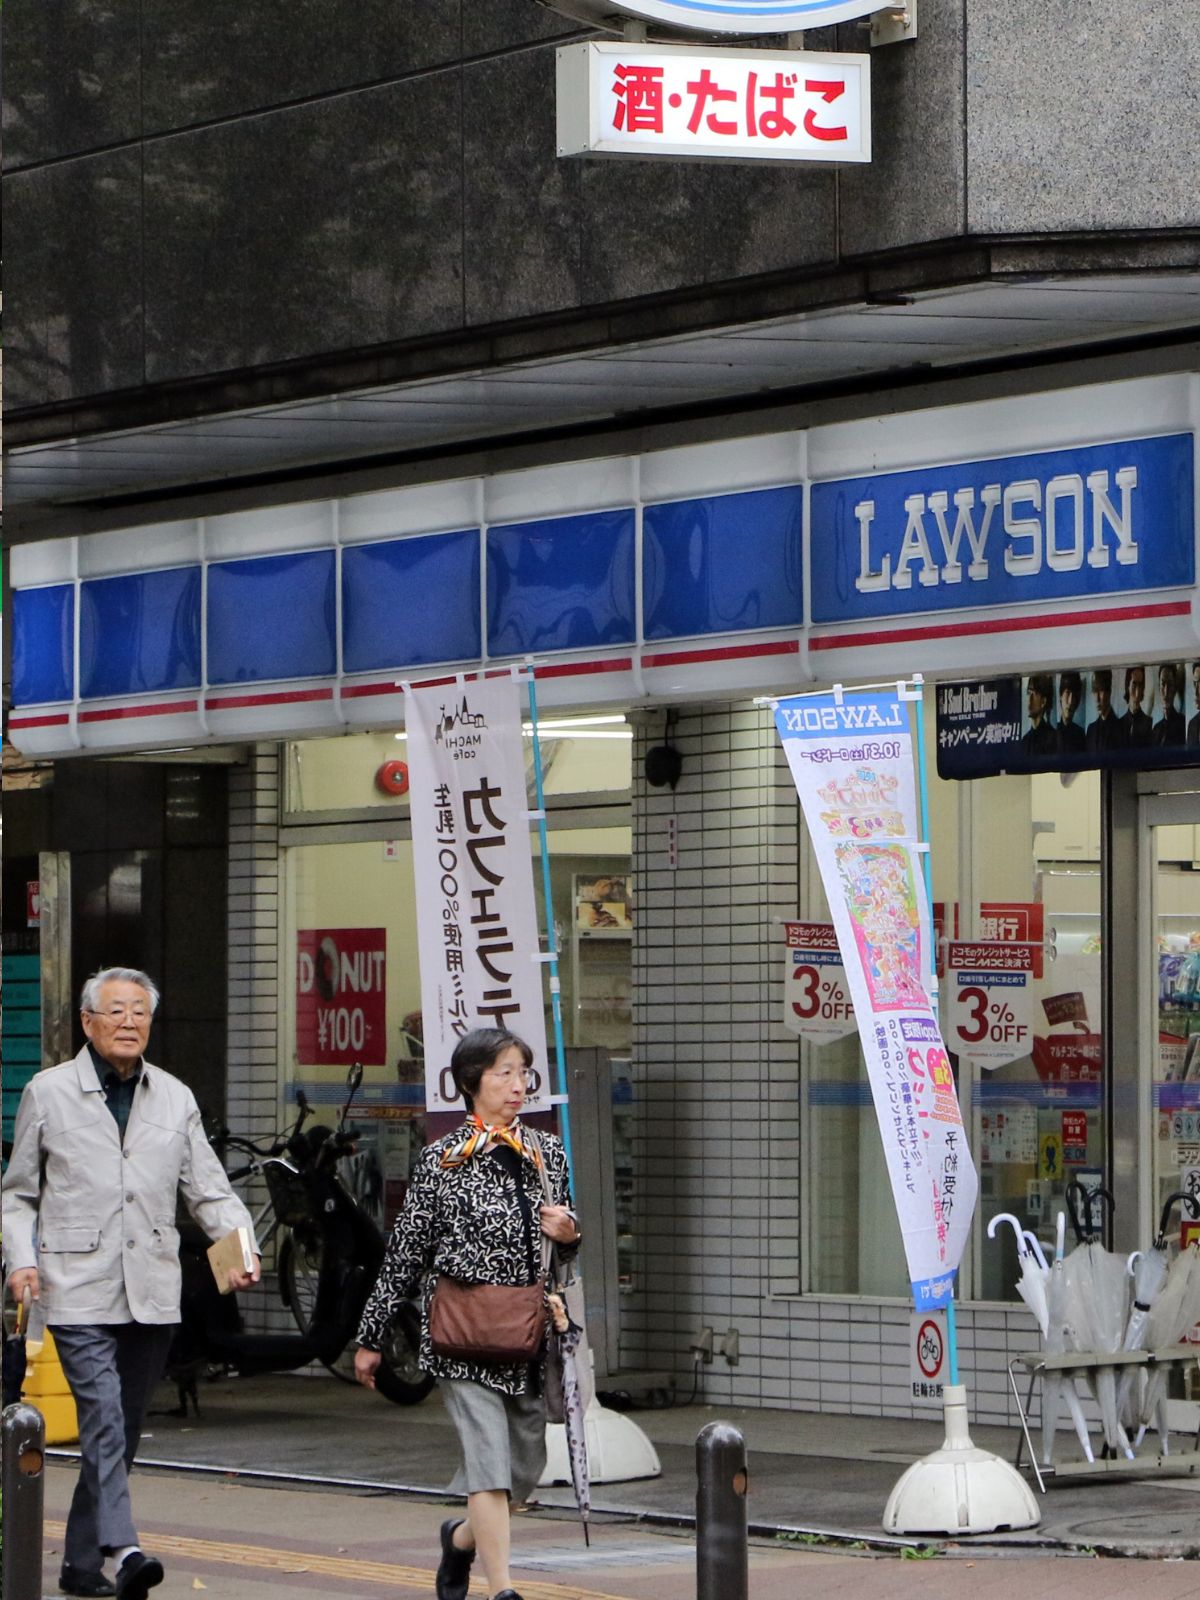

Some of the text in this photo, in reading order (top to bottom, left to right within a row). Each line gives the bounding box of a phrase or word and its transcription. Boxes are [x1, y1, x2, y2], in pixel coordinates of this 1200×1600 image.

[611, 62, 848, 141] 酒・たばこ
[854, 466, 1138, 593] LAWSON
[300, 937, 385, 1001] DONUT
[821, 1002, 855, 1021] OFF
[990, 1025, 1029, 1043] OFF
